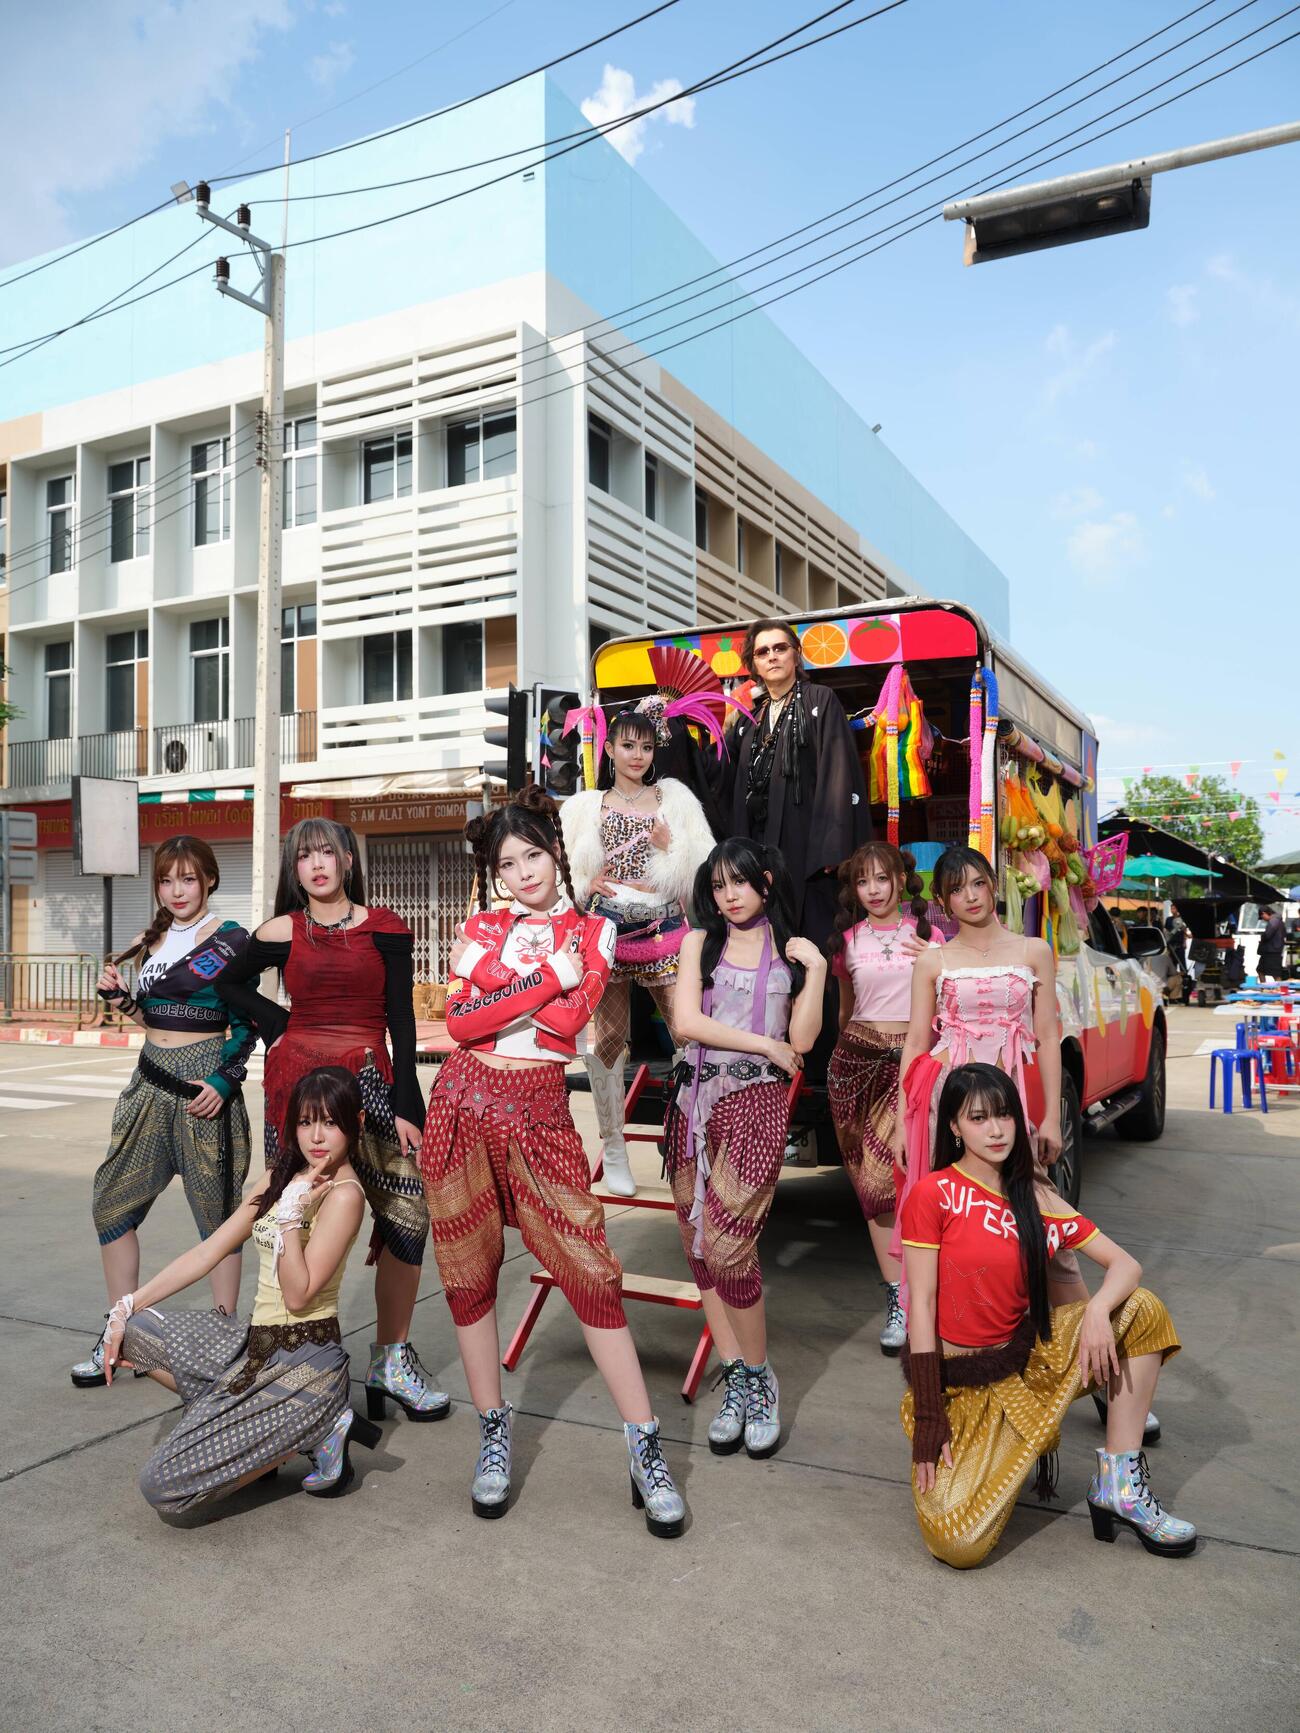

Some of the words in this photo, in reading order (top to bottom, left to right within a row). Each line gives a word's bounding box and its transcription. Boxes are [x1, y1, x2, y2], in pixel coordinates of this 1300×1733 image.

[378, 806, 403, 821] ALAI
[407, 805, 432, 819] YONT
[434, 803, 467, 818] COMPA
[193, 954, 220, 976] 221
